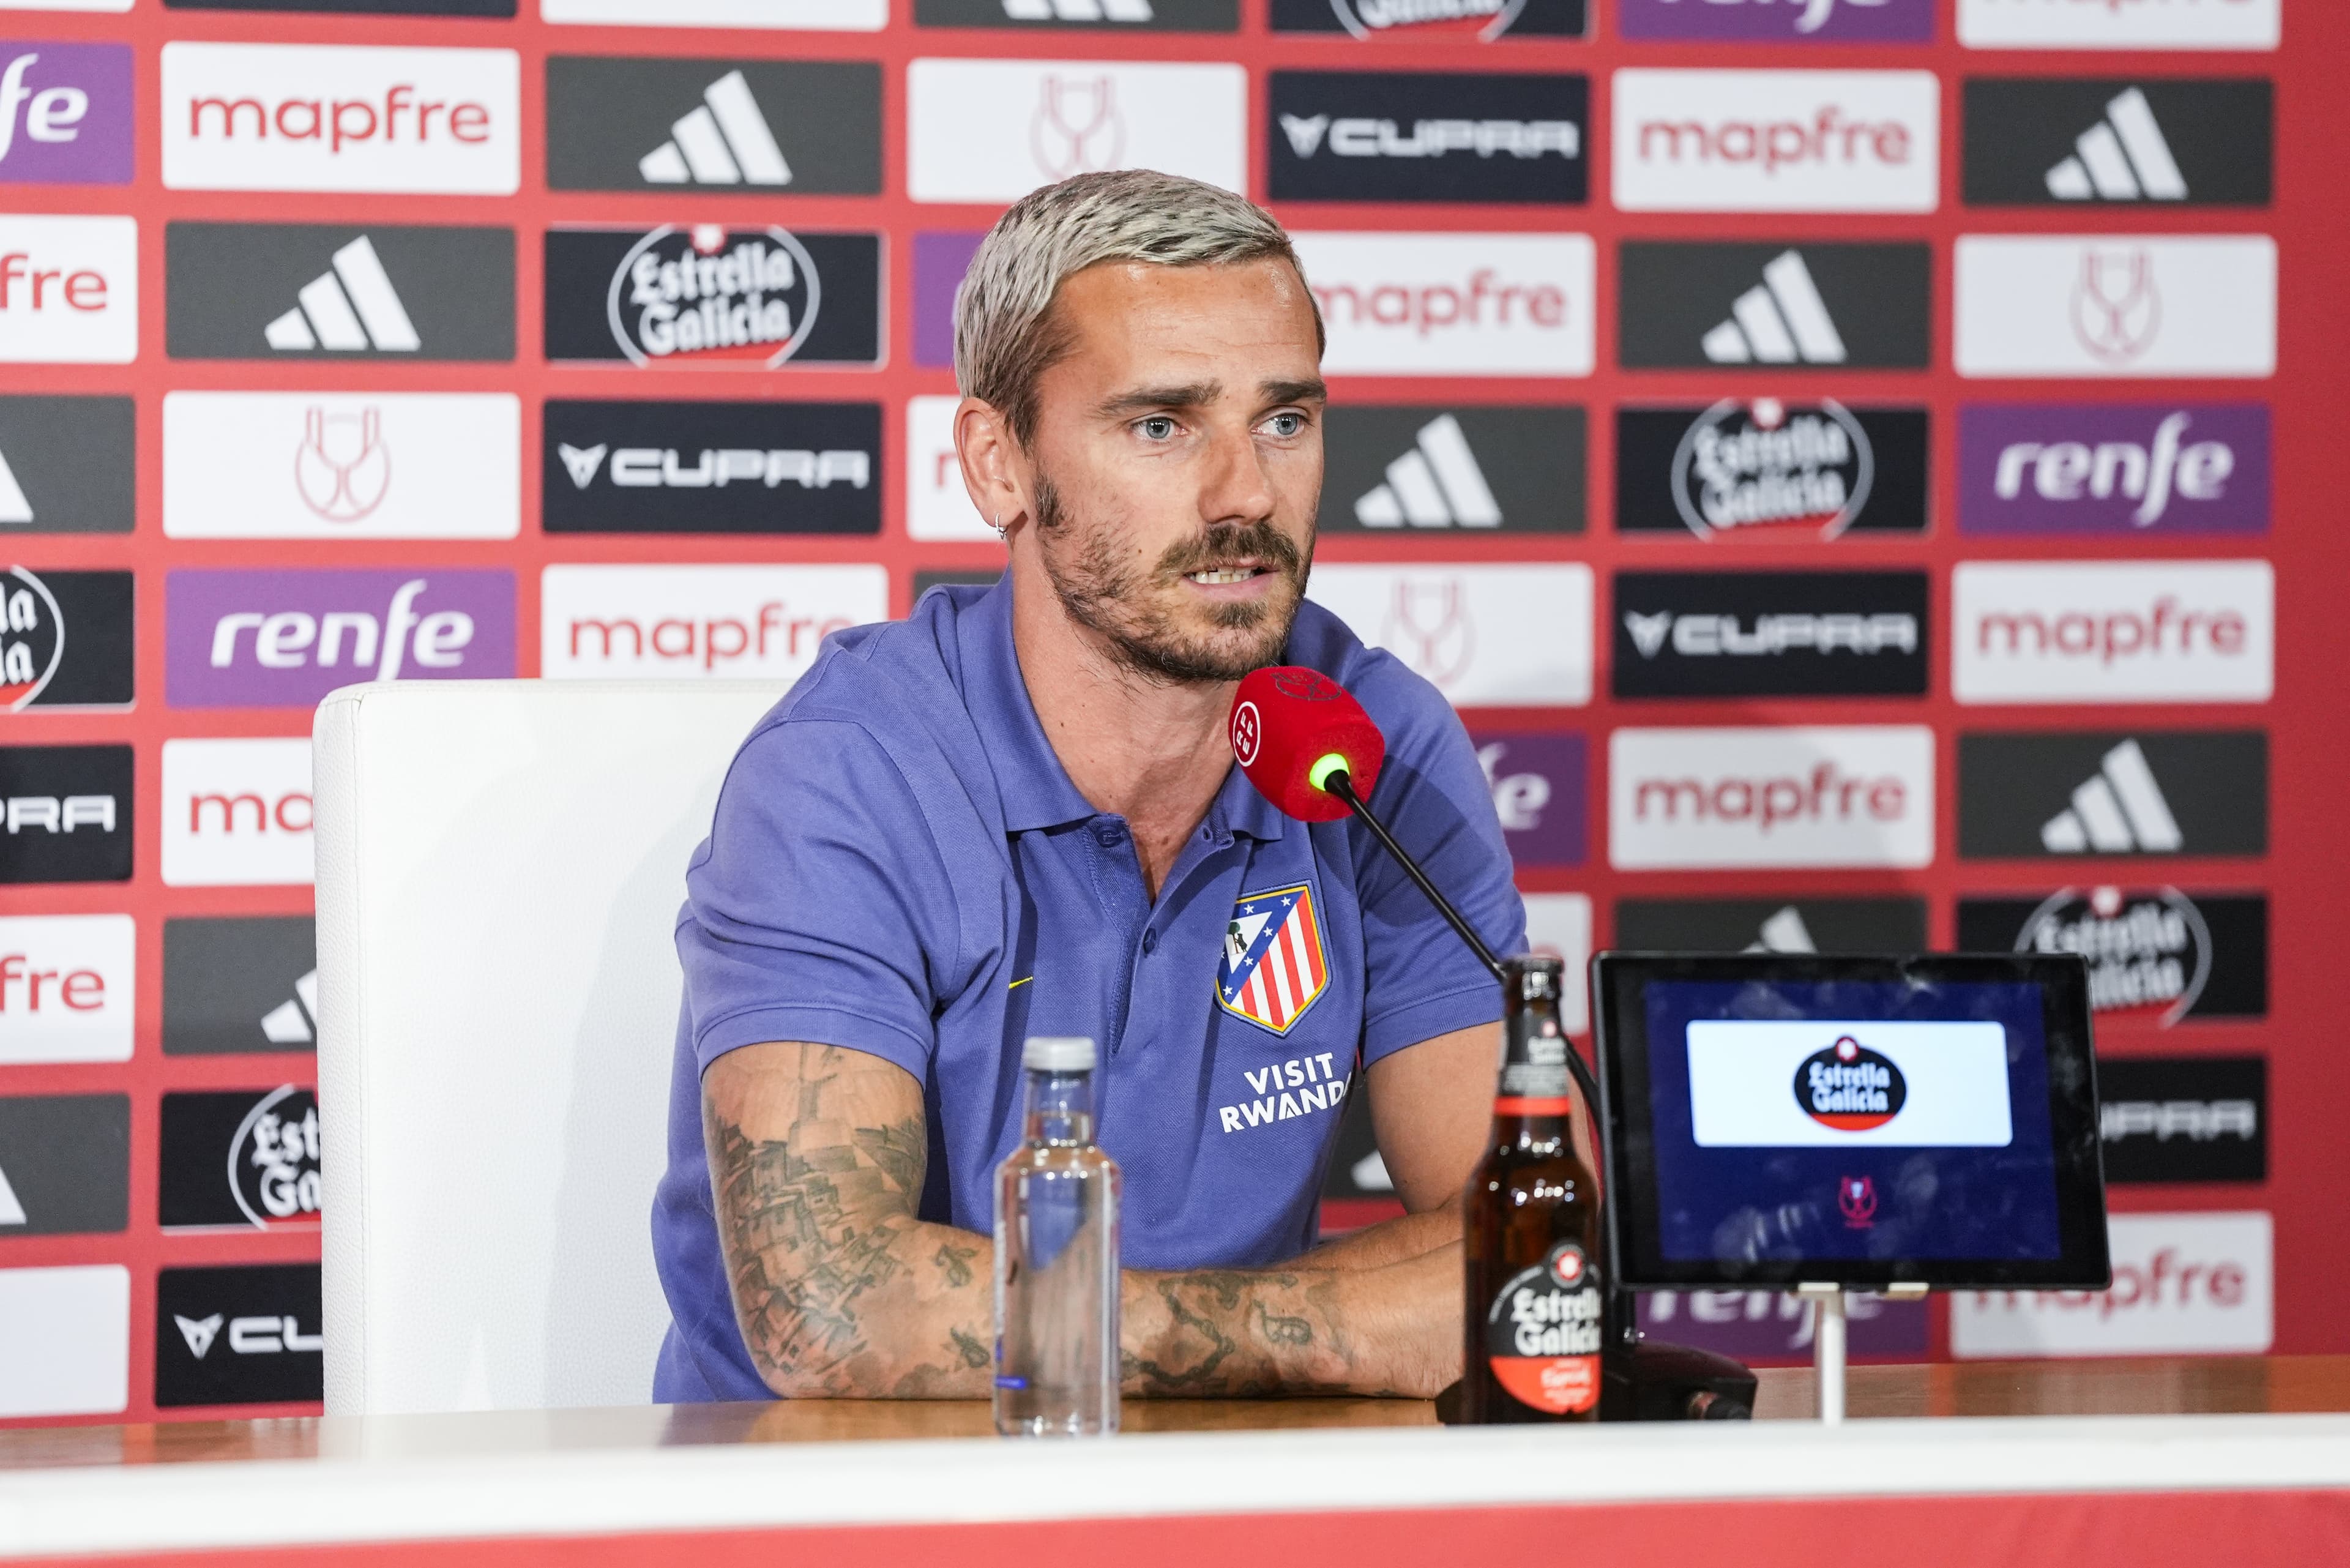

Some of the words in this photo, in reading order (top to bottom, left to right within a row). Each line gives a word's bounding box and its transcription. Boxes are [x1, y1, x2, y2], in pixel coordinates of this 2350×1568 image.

[190, 85, 490, 153] mapfre
[1329, 118, 1580, 157] CUPRA
[1638, 106, 1911, 173] mapfre
[0, 253, 107, 311] fre
[630, 242, 794, 305] Estrella
[1310, 269, 1565, 337] mapfre
[639, 293, 791, 356] Galicia
[610, 448, 870, 488] CUPRA
[1693, 415, 1849, 481] Estrella
[1995, 413, 2233, 526] renfe
[211, 580, 474, 679] renfe
[1673, 614, 1917, 655] CUPRA
[1978, 596, 2247, 663] mapfre
[1636, 764, 1906, 827] mapfre
[0, 955, 105, 1012] fre
[1219, 1072, 1351, 1133] RWAND
[1244, 1053, 1333, 1094] VISIT
[1808, 1061, 1890, 1088] Estrella
[1811, 1083, 1889, 1112] Galicia
[1510, 1287, 1601, 1323] Estrell
